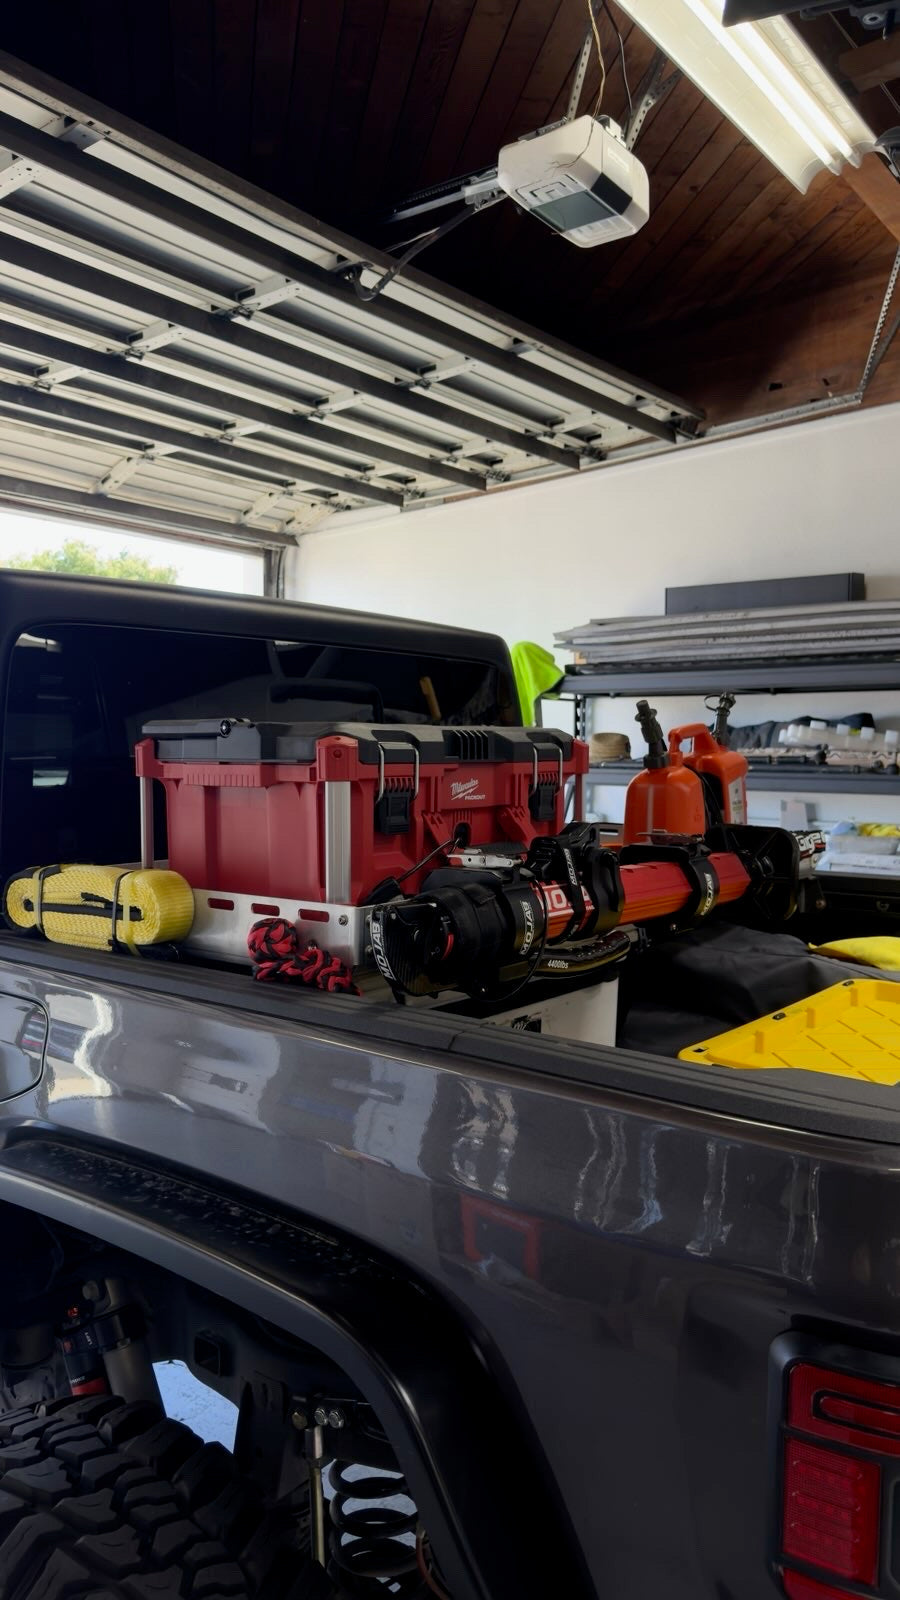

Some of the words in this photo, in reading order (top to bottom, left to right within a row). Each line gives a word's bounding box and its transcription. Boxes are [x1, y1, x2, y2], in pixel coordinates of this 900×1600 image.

[450, 777, 479, 796] Milwaukee
[519, 901, 534, 955] MOJAB
[371, 920, 395, 980] MOJAB
[547, 959, 570, 969] 4400lbs
